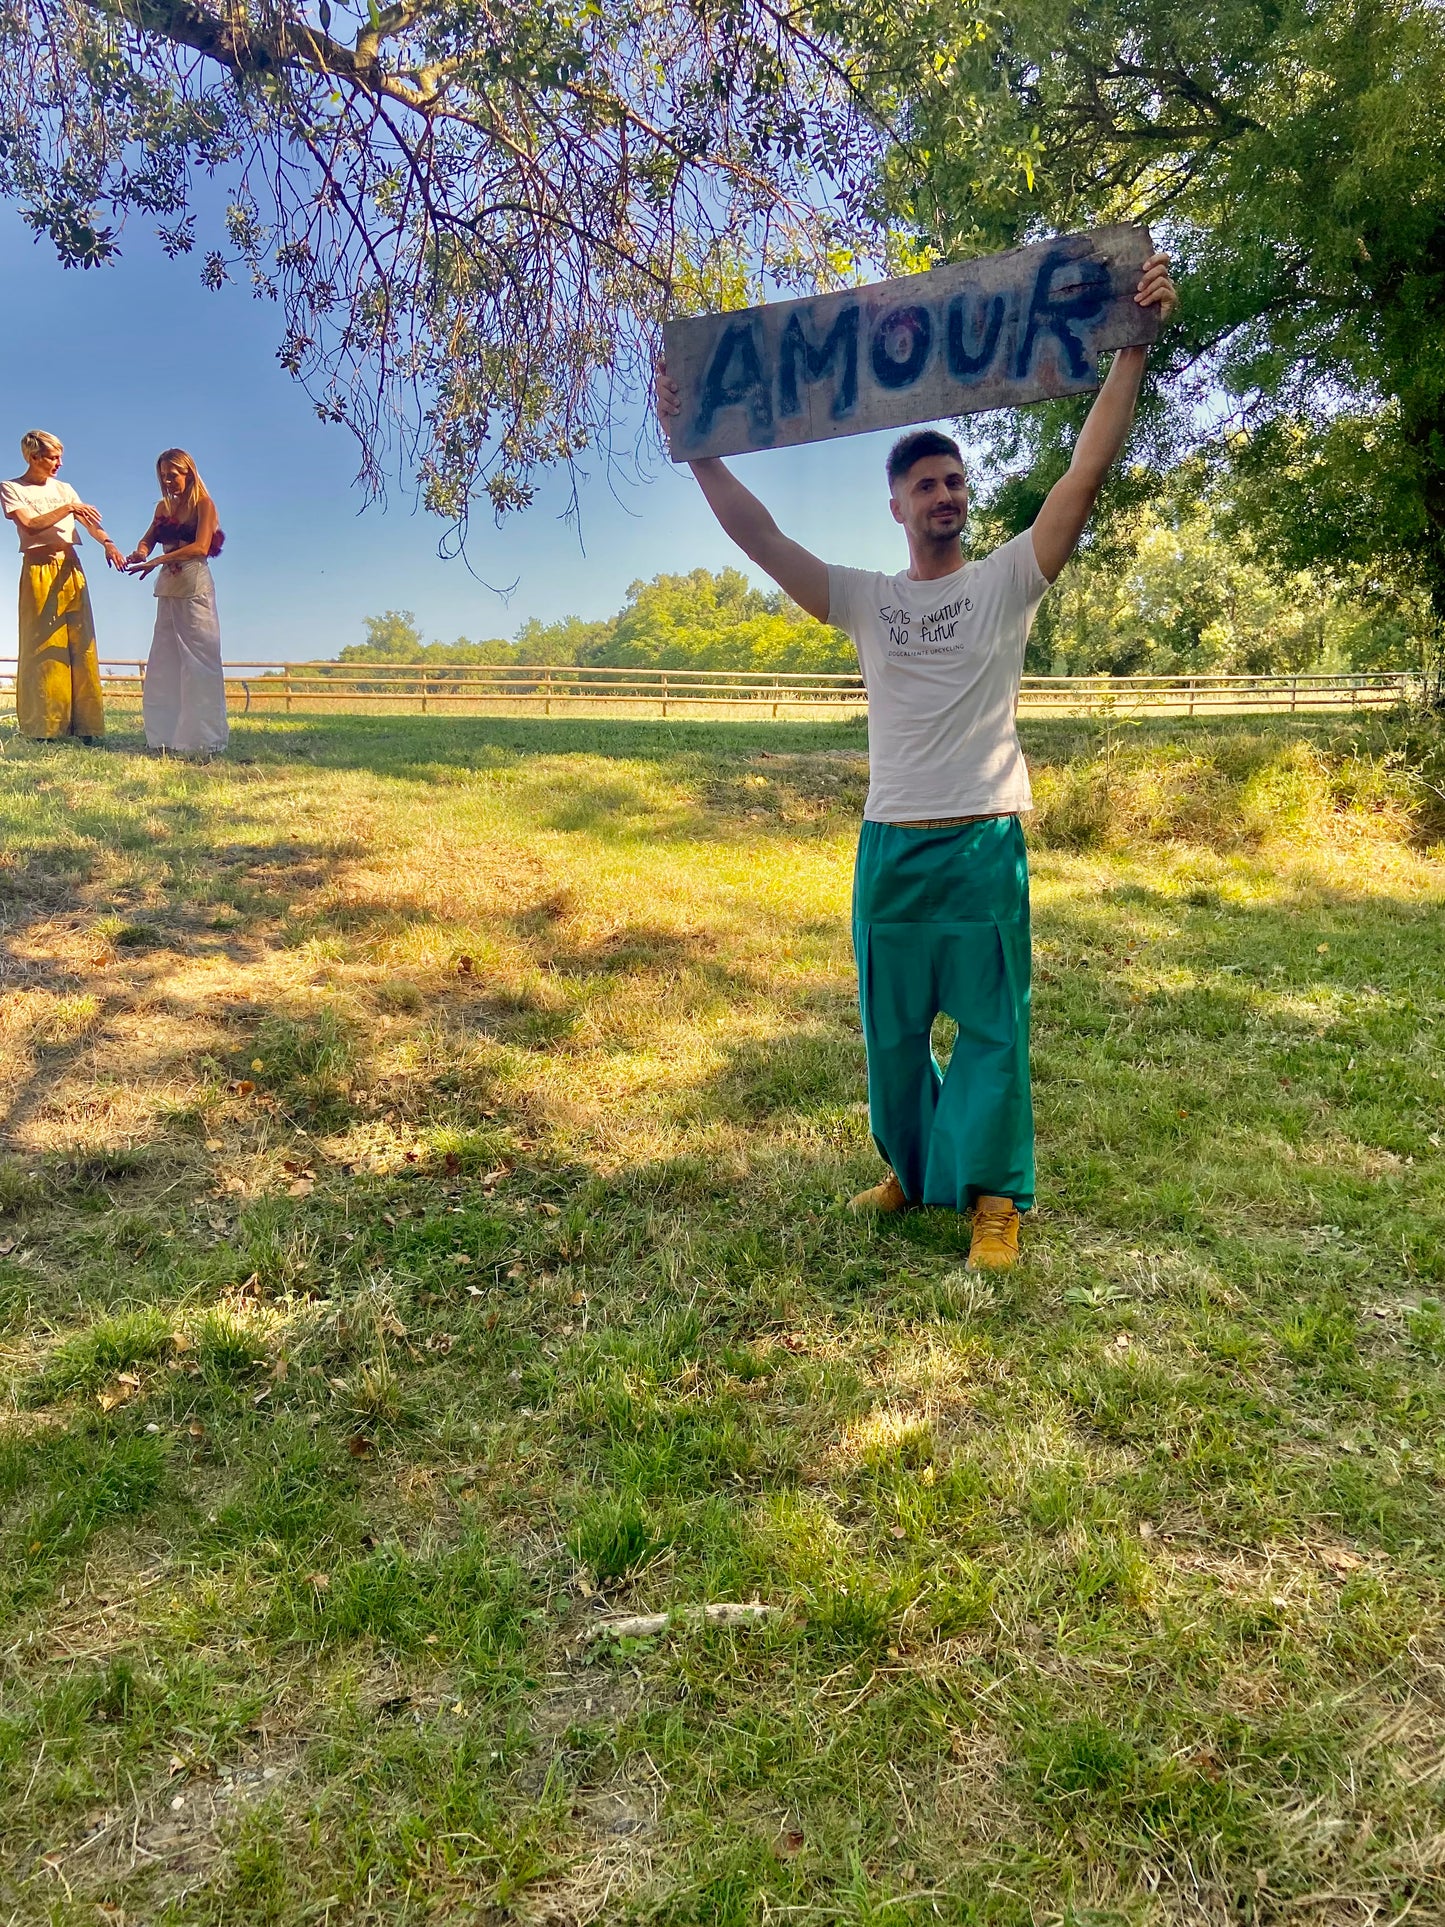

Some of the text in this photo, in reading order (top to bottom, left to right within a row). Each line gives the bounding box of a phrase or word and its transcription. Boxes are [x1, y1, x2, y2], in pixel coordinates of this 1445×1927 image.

[683, 235, 1113, 449] AMOUR
[889, 625, 909, 646] No
[930, 643, 965, 655] UPCYCLING
